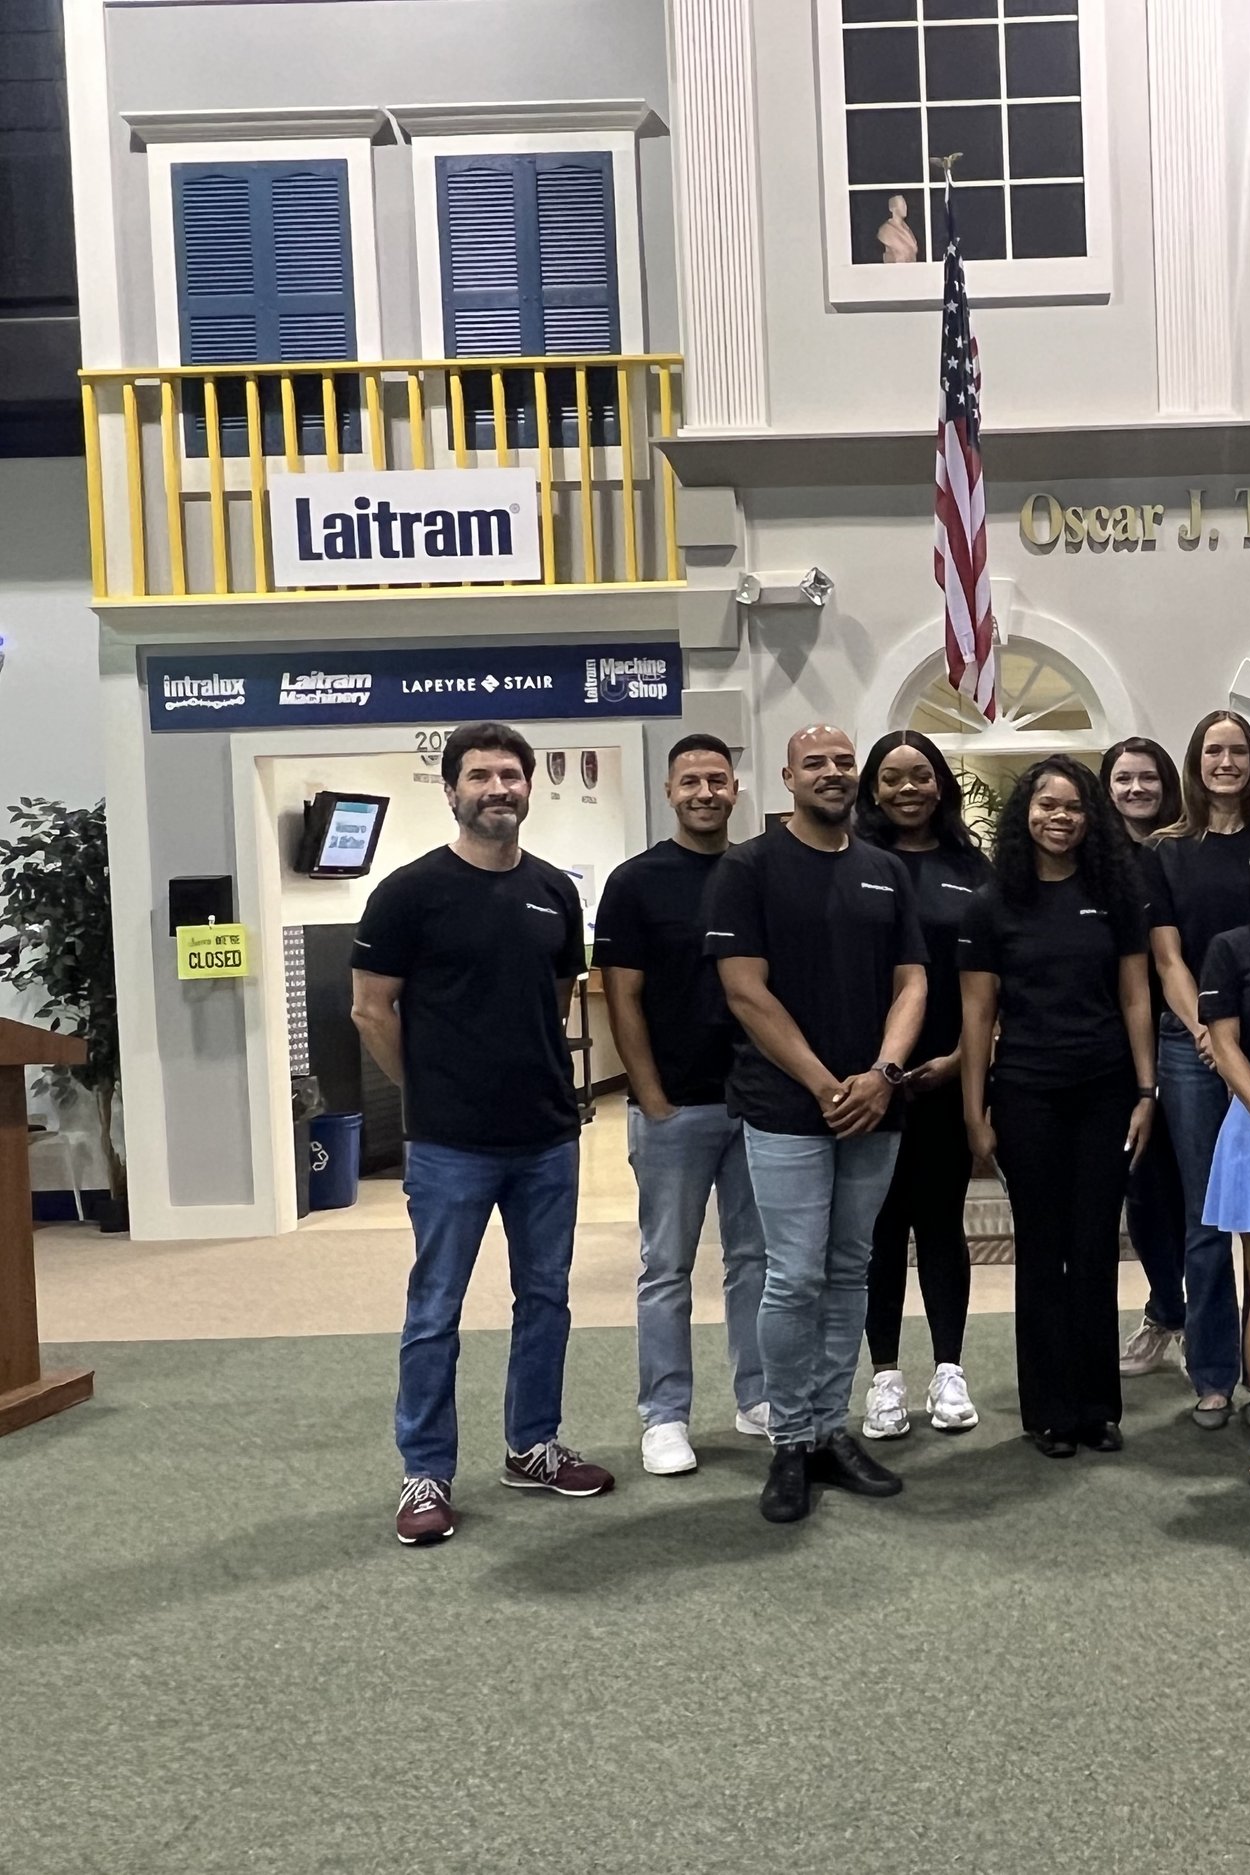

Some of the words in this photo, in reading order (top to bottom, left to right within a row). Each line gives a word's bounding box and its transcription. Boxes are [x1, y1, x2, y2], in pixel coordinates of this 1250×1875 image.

[1020, 492, 1165, 545] Oscar
[1179, 488, 1219, 542] J.
[296, 496, 514, 561] Laitram
[600, 657, 667, 682] Machine
[281, 670, 372, 690] Laitram
[402, 678, 477, 693] LAPEYRE
[504, 675, 553, 690] STAIR
[279, 689, 370, 706] Machinery
[628, 681, 668, 700] Shop
[415, 731, 453, 751] 20
[188, 950, 242, 969] CLOSED
